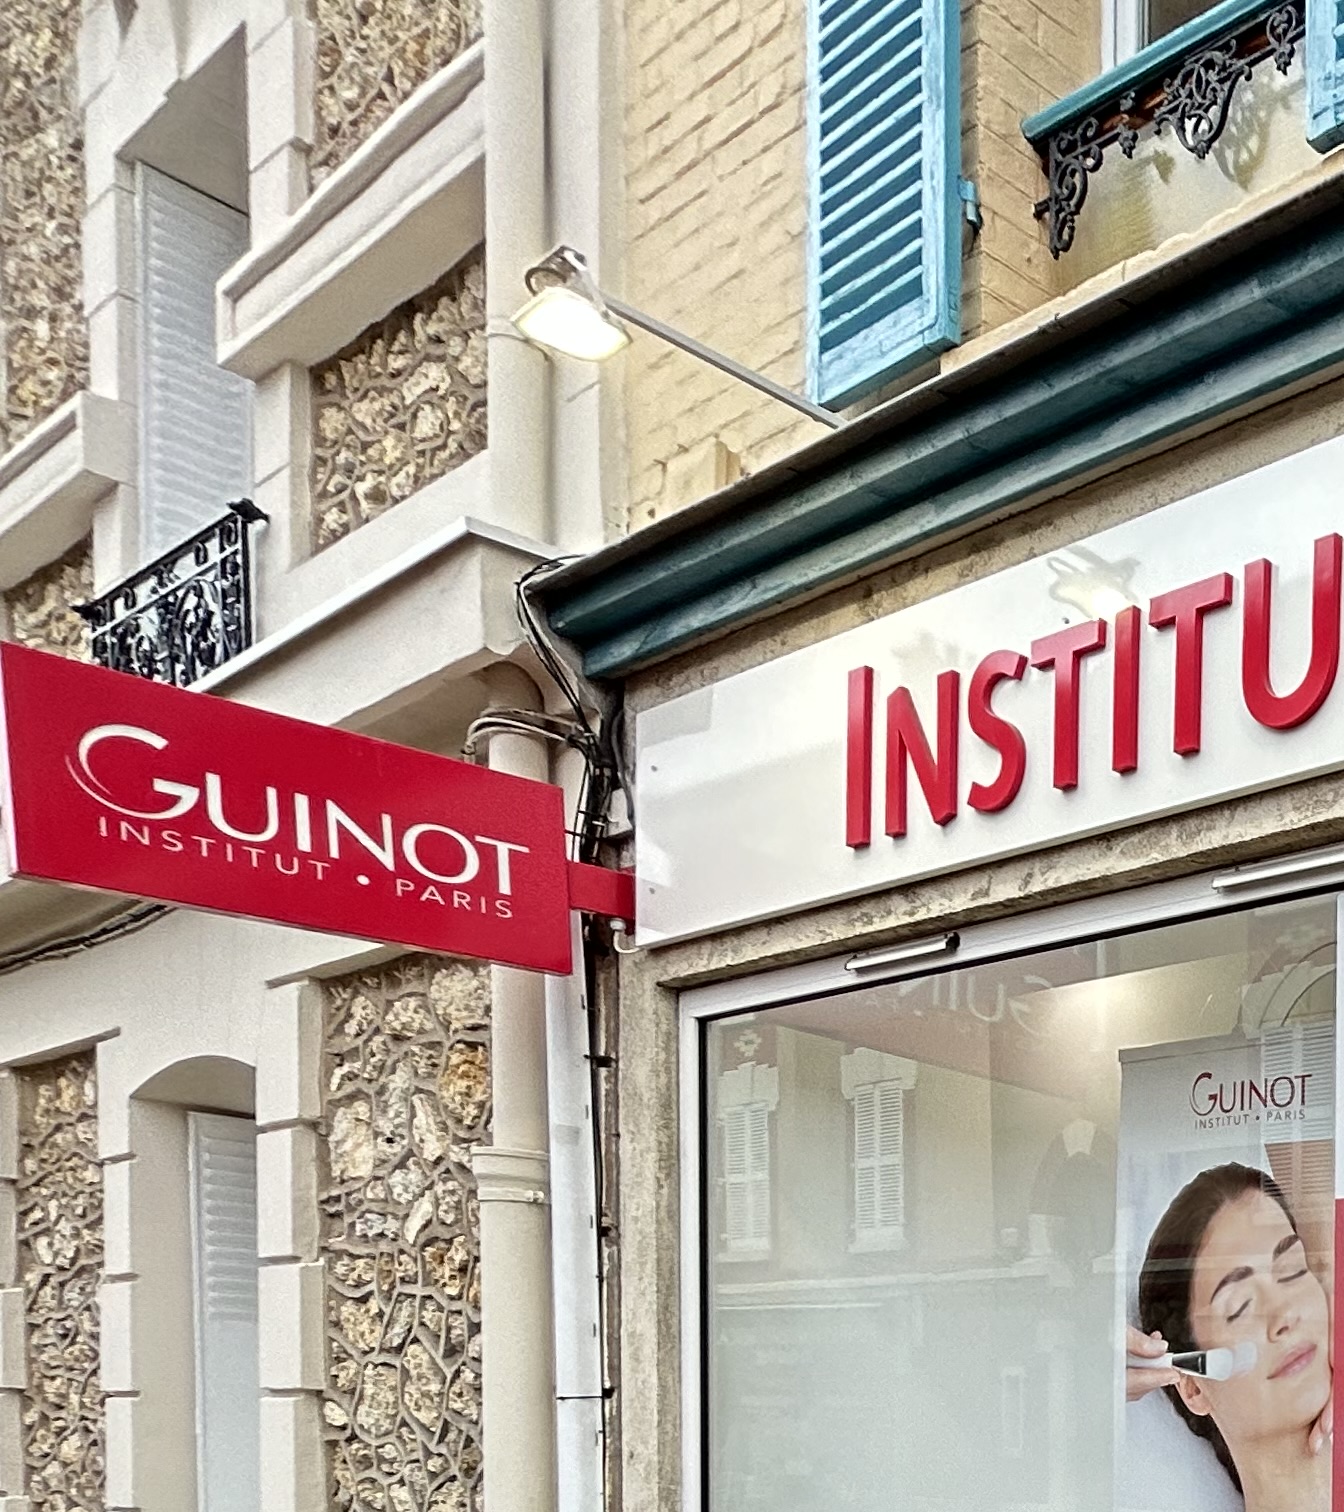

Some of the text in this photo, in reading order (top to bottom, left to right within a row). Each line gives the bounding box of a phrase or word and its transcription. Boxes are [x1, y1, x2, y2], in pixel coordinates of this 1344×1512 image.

[64, 724, 530, 896] GUINOT
[99, 816, 514, 919] INSTITUT PARIS
[1189, 1071, 1314, 1117] GUINOT
[1194, 1108, 1306, 1131] INSTITUT PARIS
